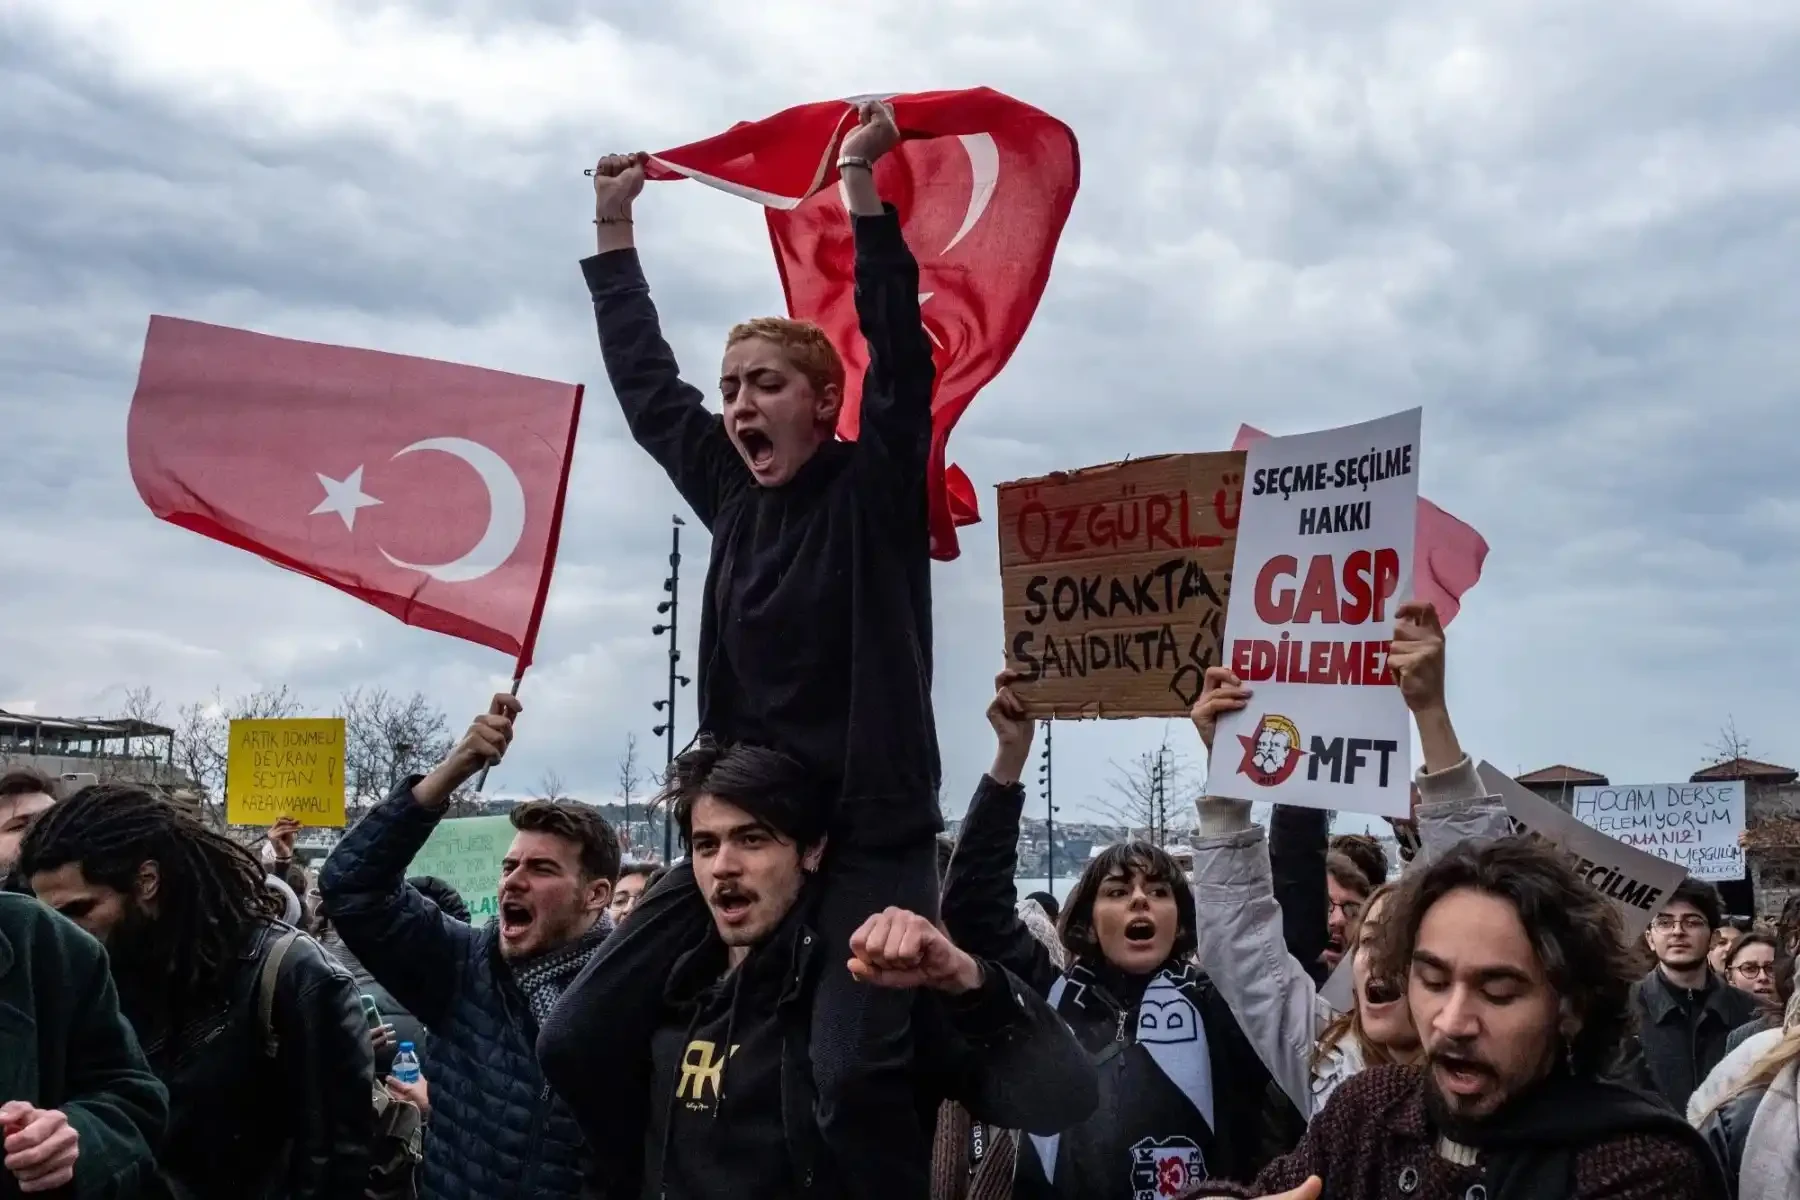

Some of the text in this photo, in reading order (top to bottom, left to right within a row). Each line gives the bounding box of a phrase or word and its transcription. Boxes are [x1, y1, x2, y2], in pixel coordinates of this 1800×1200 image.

[1252, 444, 1412, 500] SEÇME-SEÇİLME
[1017, 474, 1240, 560] ÖZGÜRLÜ
[1298, 501, 1371, 536] HAKKI
[1024, 556, 1221, 625] SOKAKTA
[1253, 547, 1400, 625] GASP
[1013, 623, 1180, 681] SANDIKTA
[241, 730, 279, 750] ARTIK
[254, 751, 318, 769] DEVRAN
[1306, 735, 1398, 787] MFT
[1575, 789, 1655, 818] HOCAM
